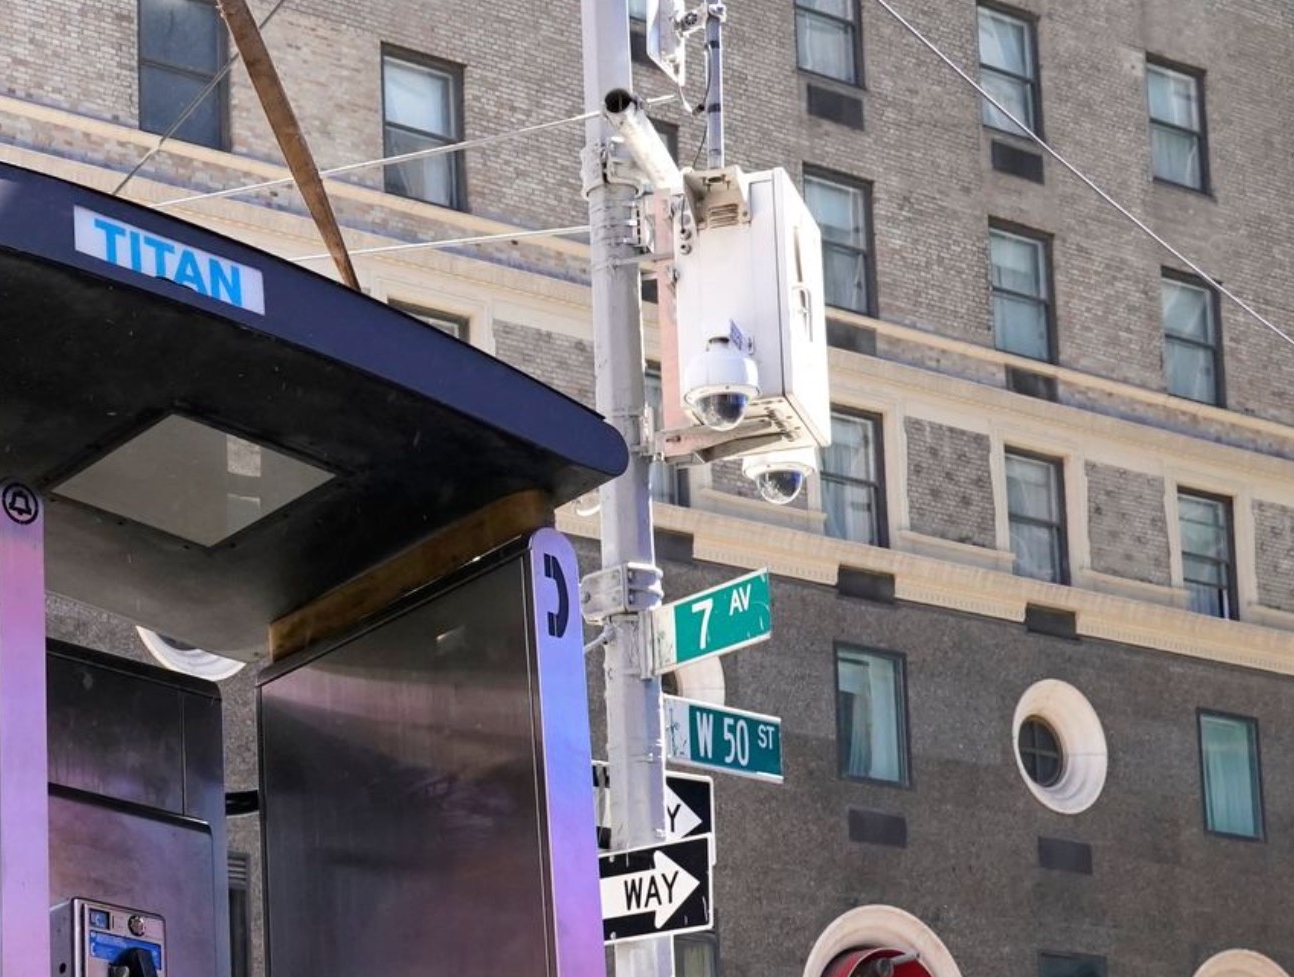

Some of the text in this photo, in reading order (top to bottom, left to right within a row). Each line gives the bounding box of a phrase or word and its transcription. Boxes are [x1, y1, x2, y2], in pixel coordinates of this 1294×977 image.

[94, 218, 242, 307] TITAN
[691, 584, 751, 649] 7 AV
[696, 711, 775, 766] W 50 ST
[624, 871, 679, 911] WAY
